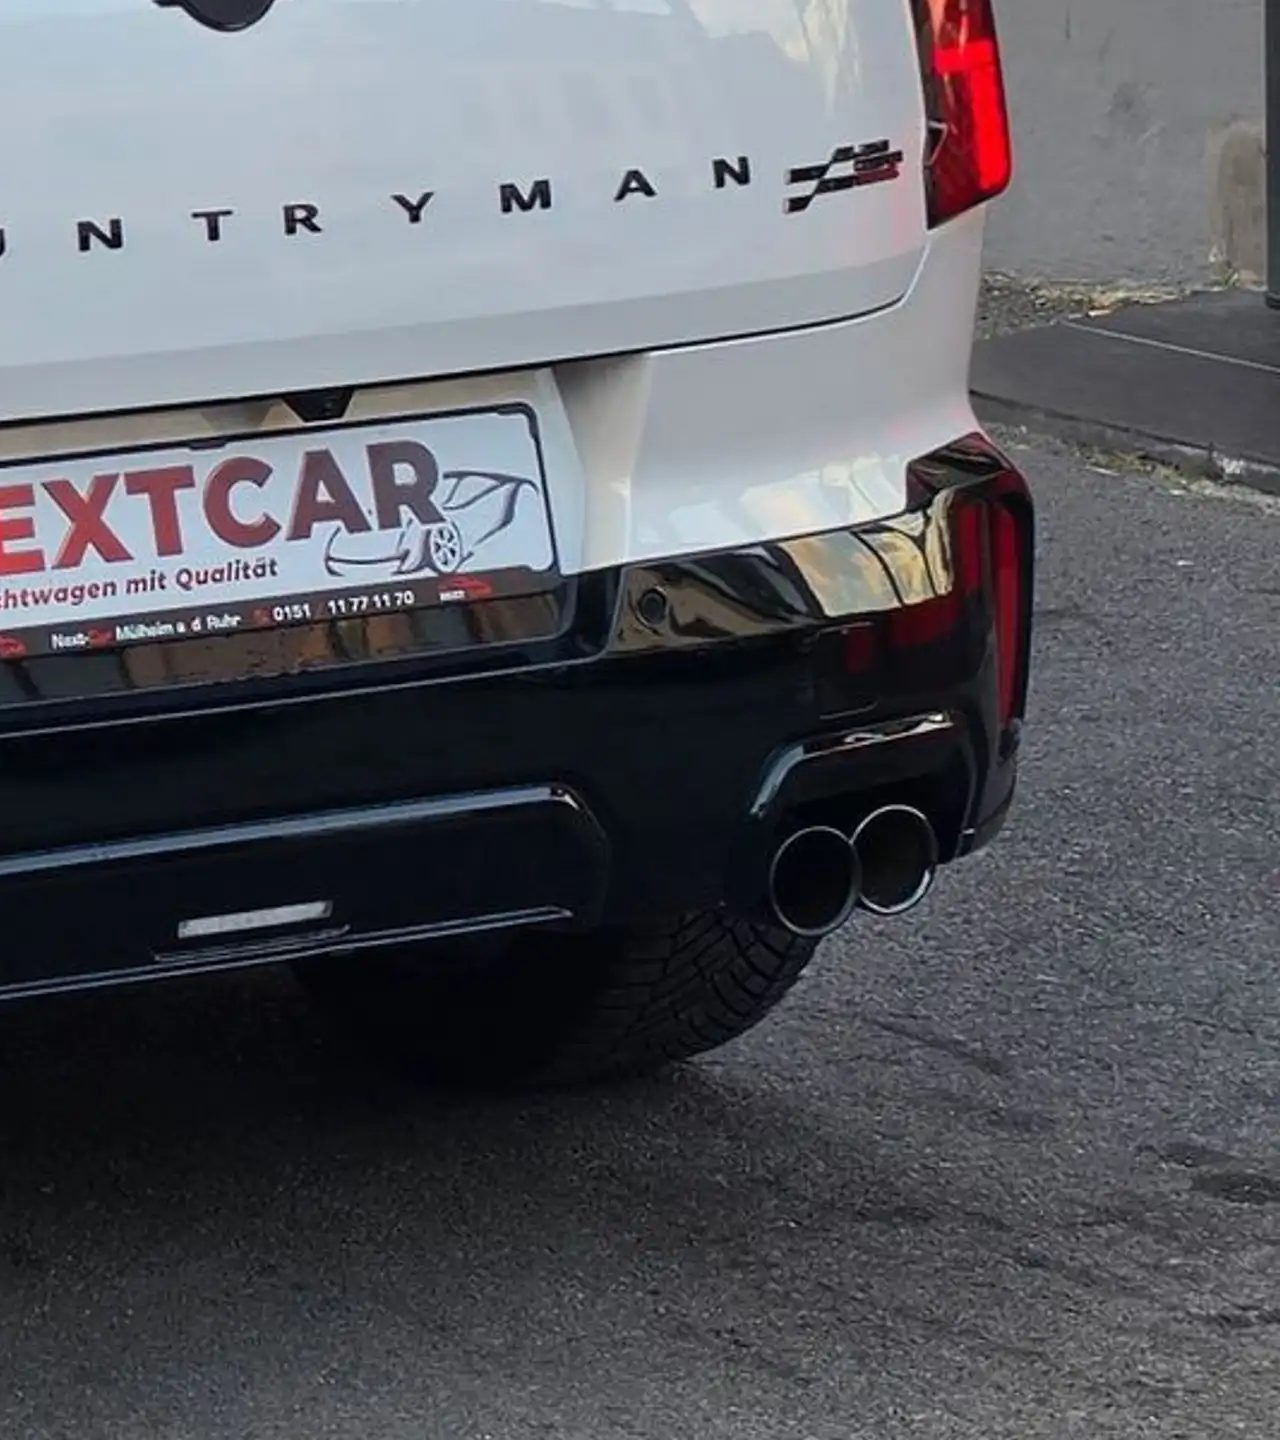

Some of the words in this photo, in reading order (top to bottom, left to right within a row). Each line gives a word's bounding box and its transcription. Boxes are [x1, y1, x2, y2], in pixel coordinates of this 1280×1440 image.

[126, 569, 167, 594] mit
[175, 557, 278, 591] Qualität
[272, 602, 312, 621] 0151
